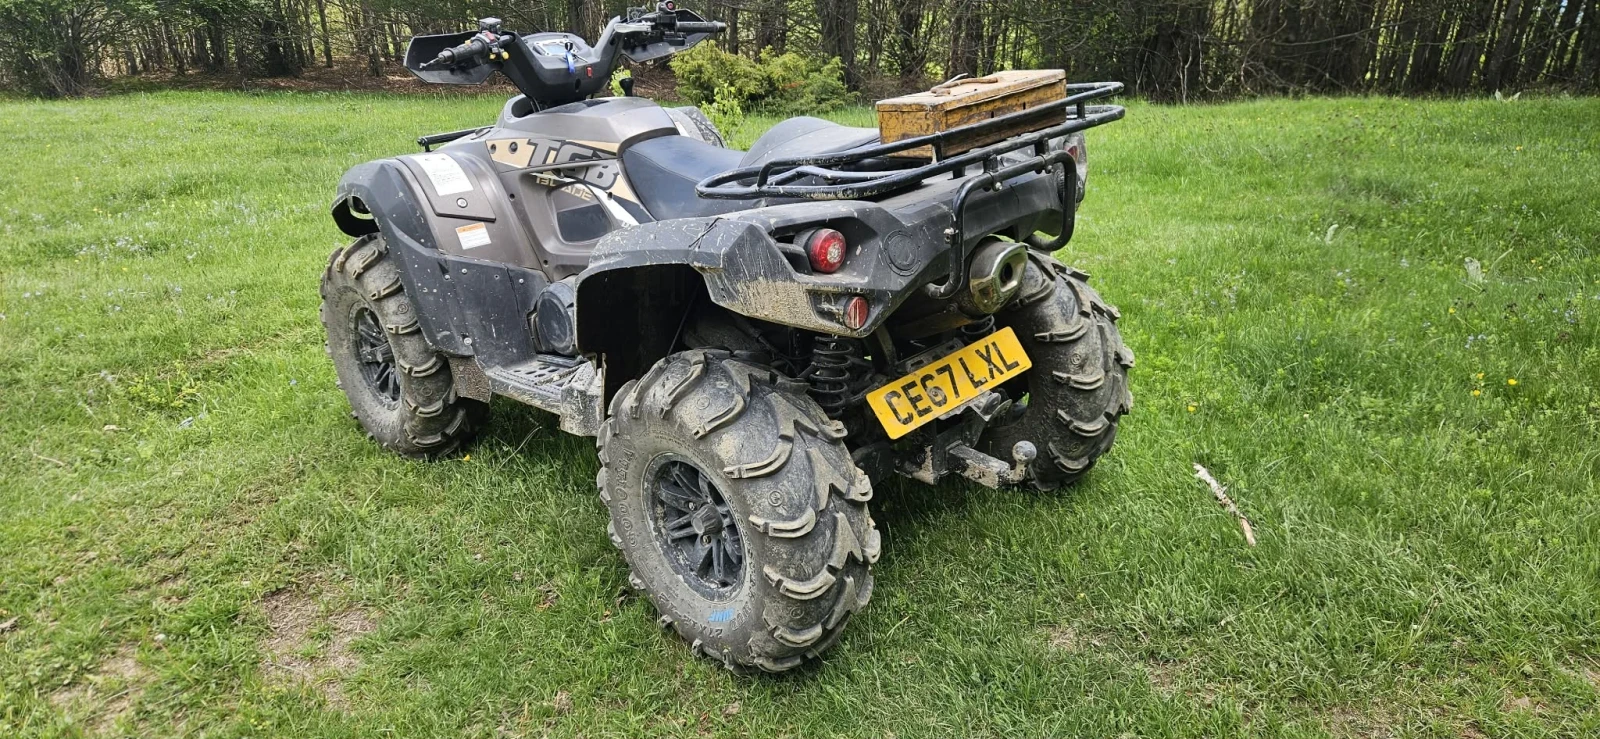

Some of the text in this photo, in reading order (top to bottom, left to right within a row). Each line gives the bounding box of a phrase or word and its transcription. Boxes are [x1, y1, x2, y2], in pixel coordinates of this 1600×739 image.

[527, 138, 620, 190] TGB
[883, 341, 1020, 426] CE67 LXL
